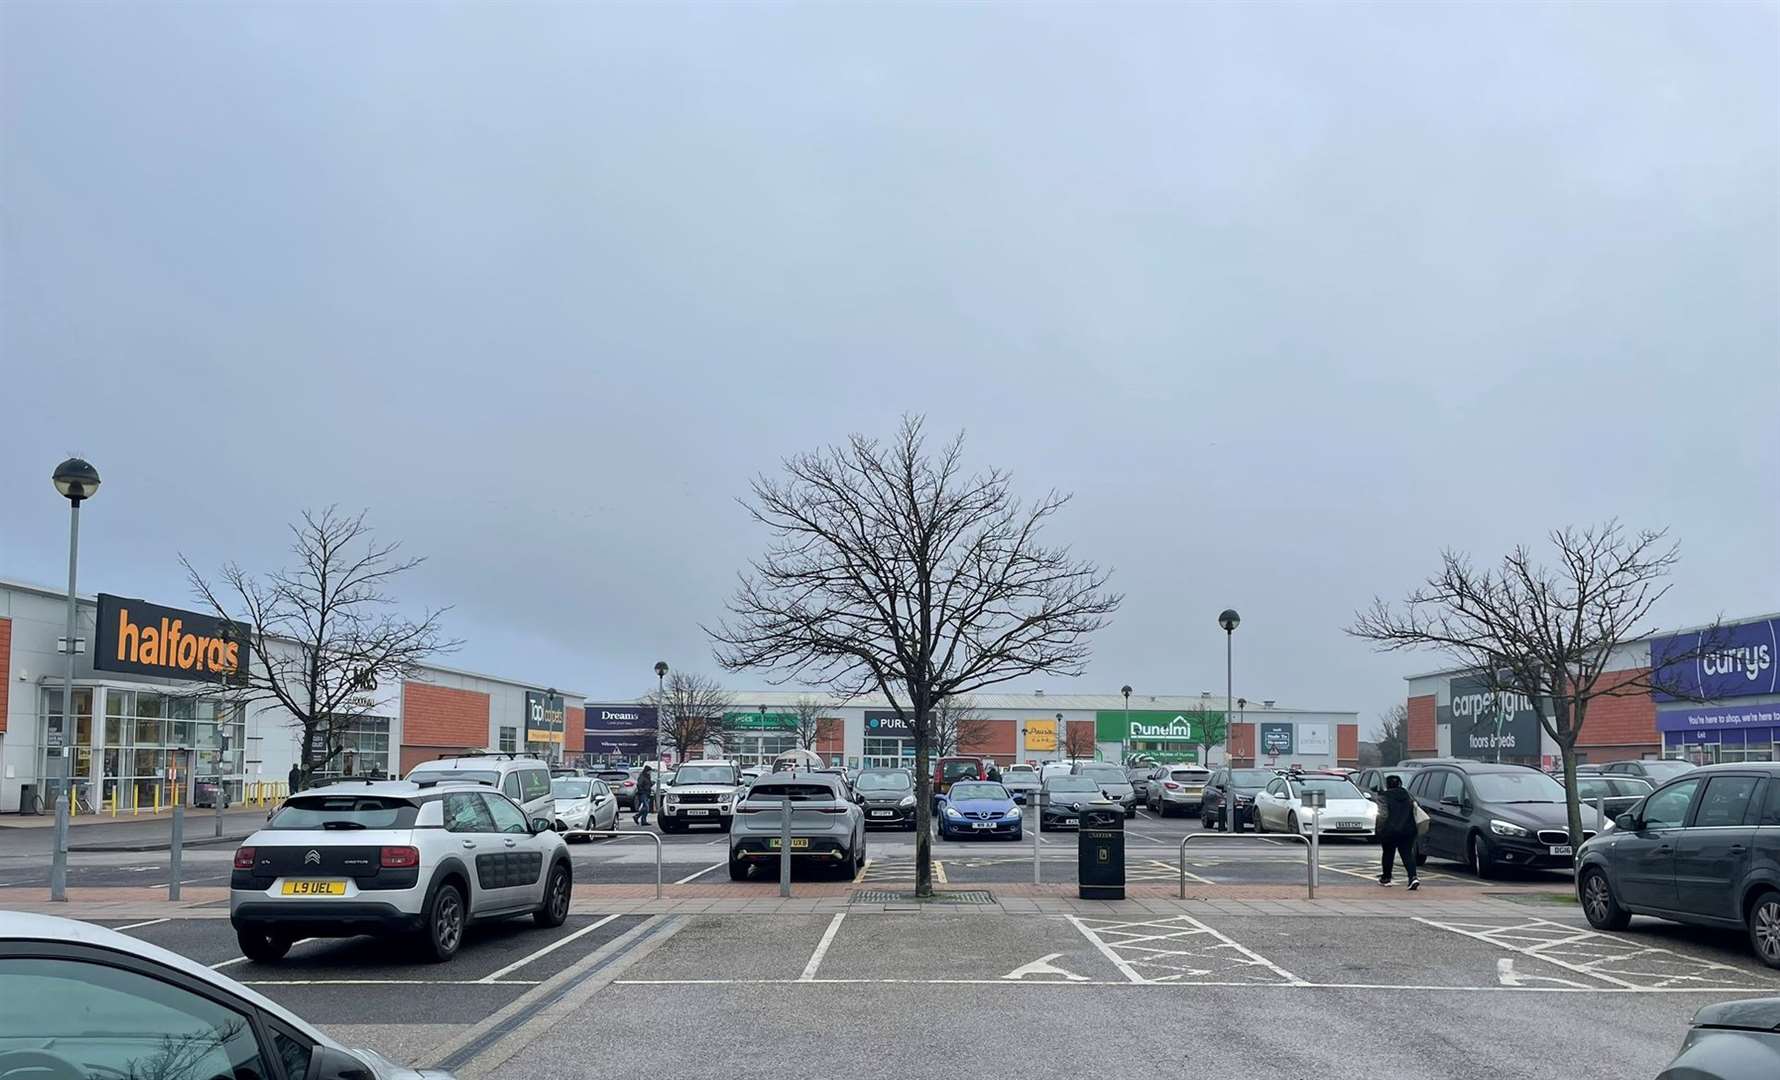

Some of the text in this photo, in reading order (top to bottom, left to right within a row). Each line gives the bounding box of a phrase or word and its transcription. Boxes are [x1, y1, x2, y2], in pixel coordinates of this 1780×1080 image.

[1704, 645, 1770, 680] currys
[1453, 691, 1533, 723] carpetight
[601, 711, 639, 720] Dreams
[1131, 722, 1187, 735] Dunelm
[1470, 734, 1488, 748] floors
[293, 882, 333, 893] L9 UEL
